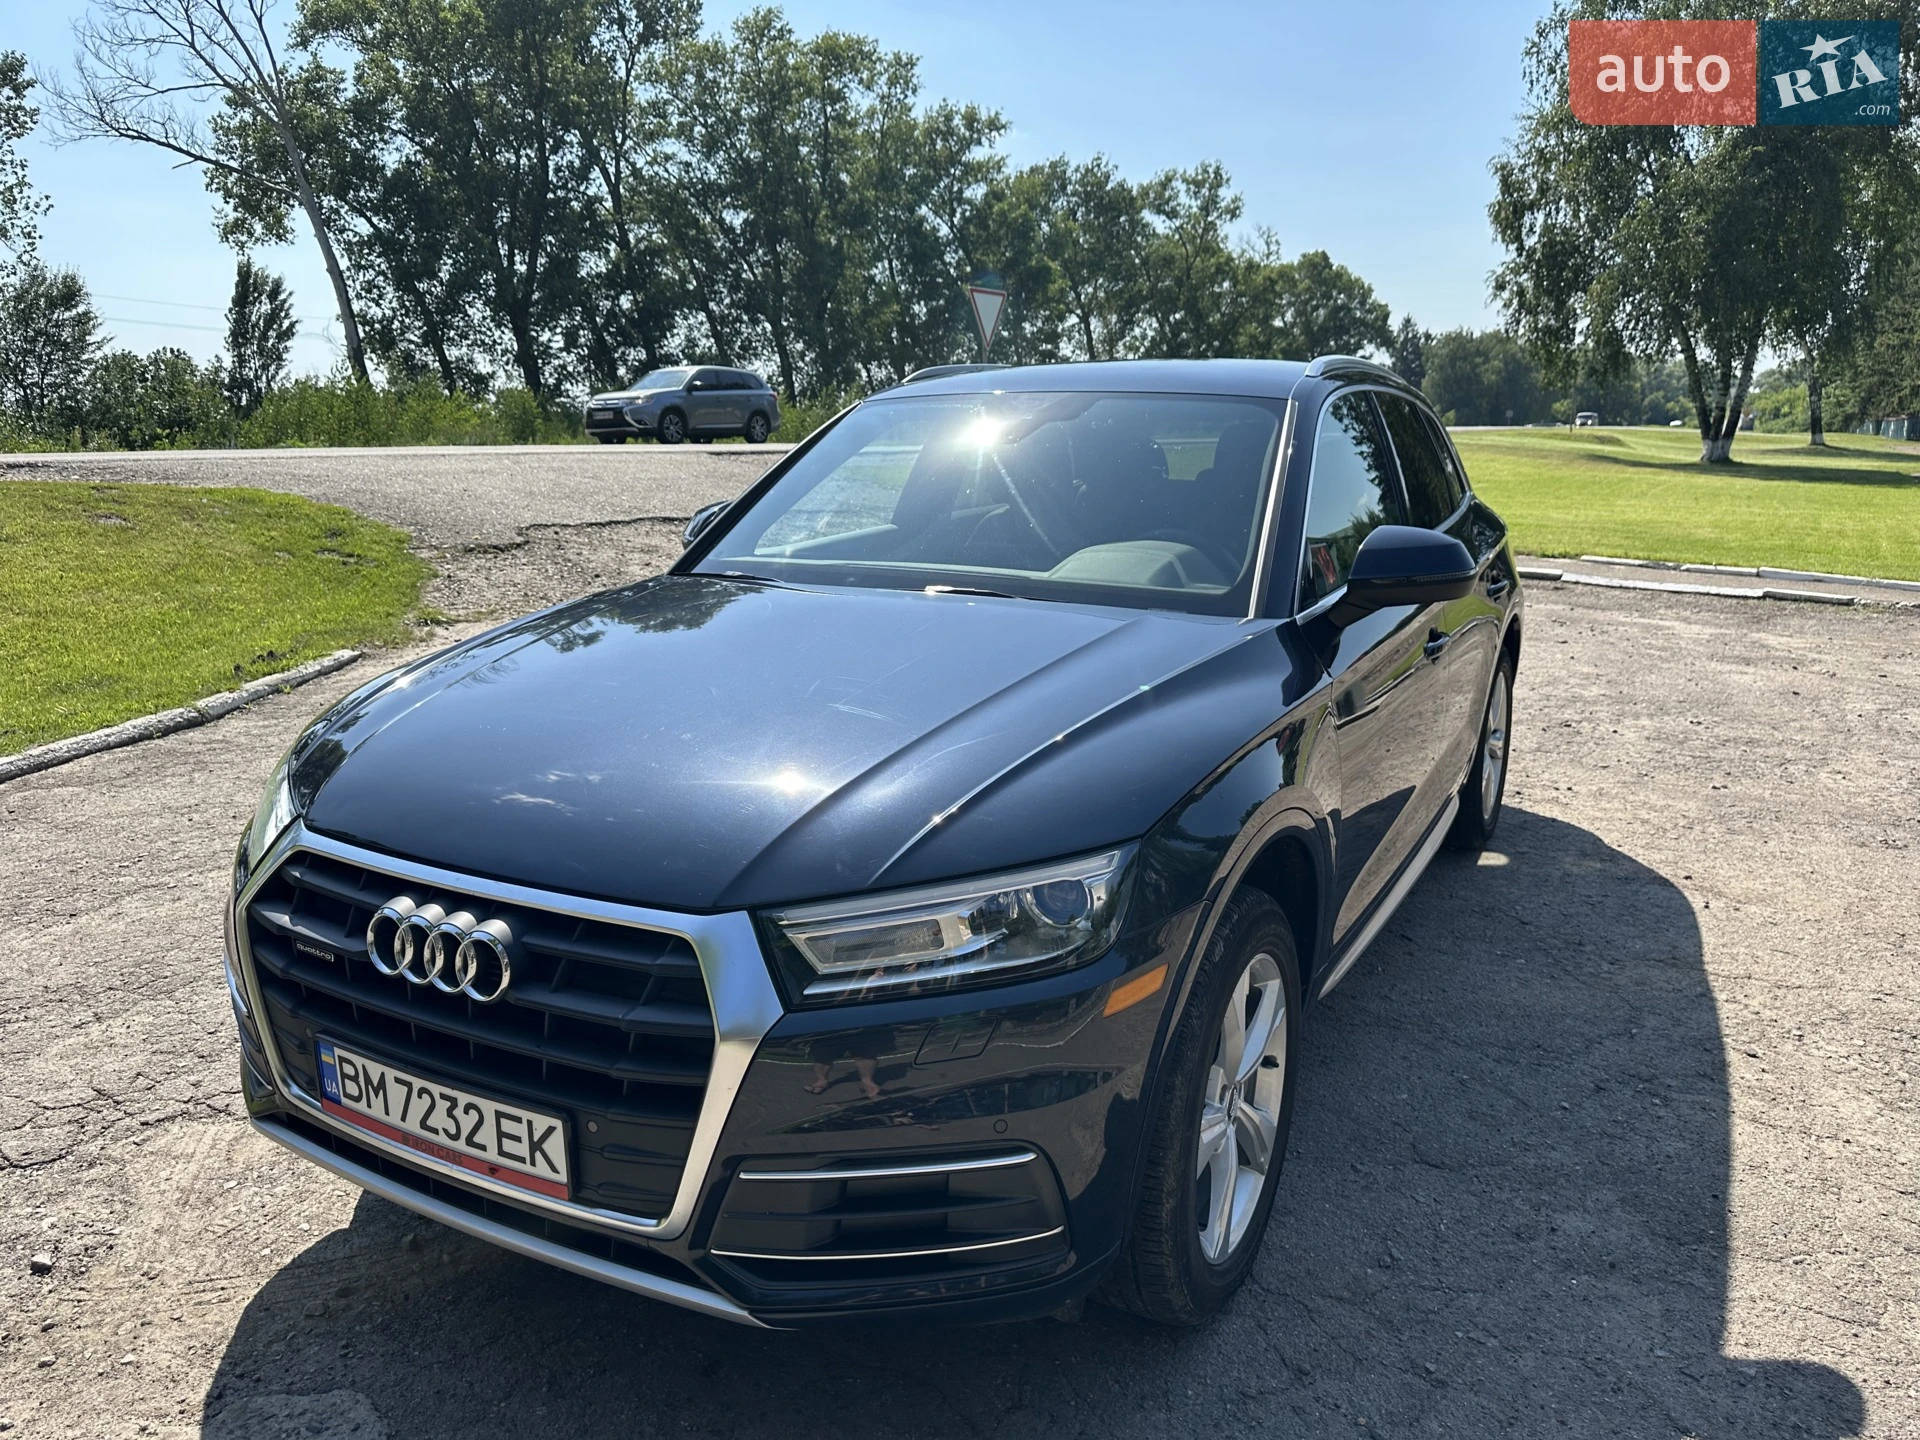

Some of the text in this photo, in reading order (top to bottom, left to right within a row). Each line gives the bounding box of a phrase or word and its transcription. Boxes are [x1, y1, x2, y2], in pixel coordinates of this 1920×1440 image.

[296, 943, 332, 960] quattro
[325, 1078, 339, 1096] UA
[337, 1055, 560, 1174] BM 7232 EK
